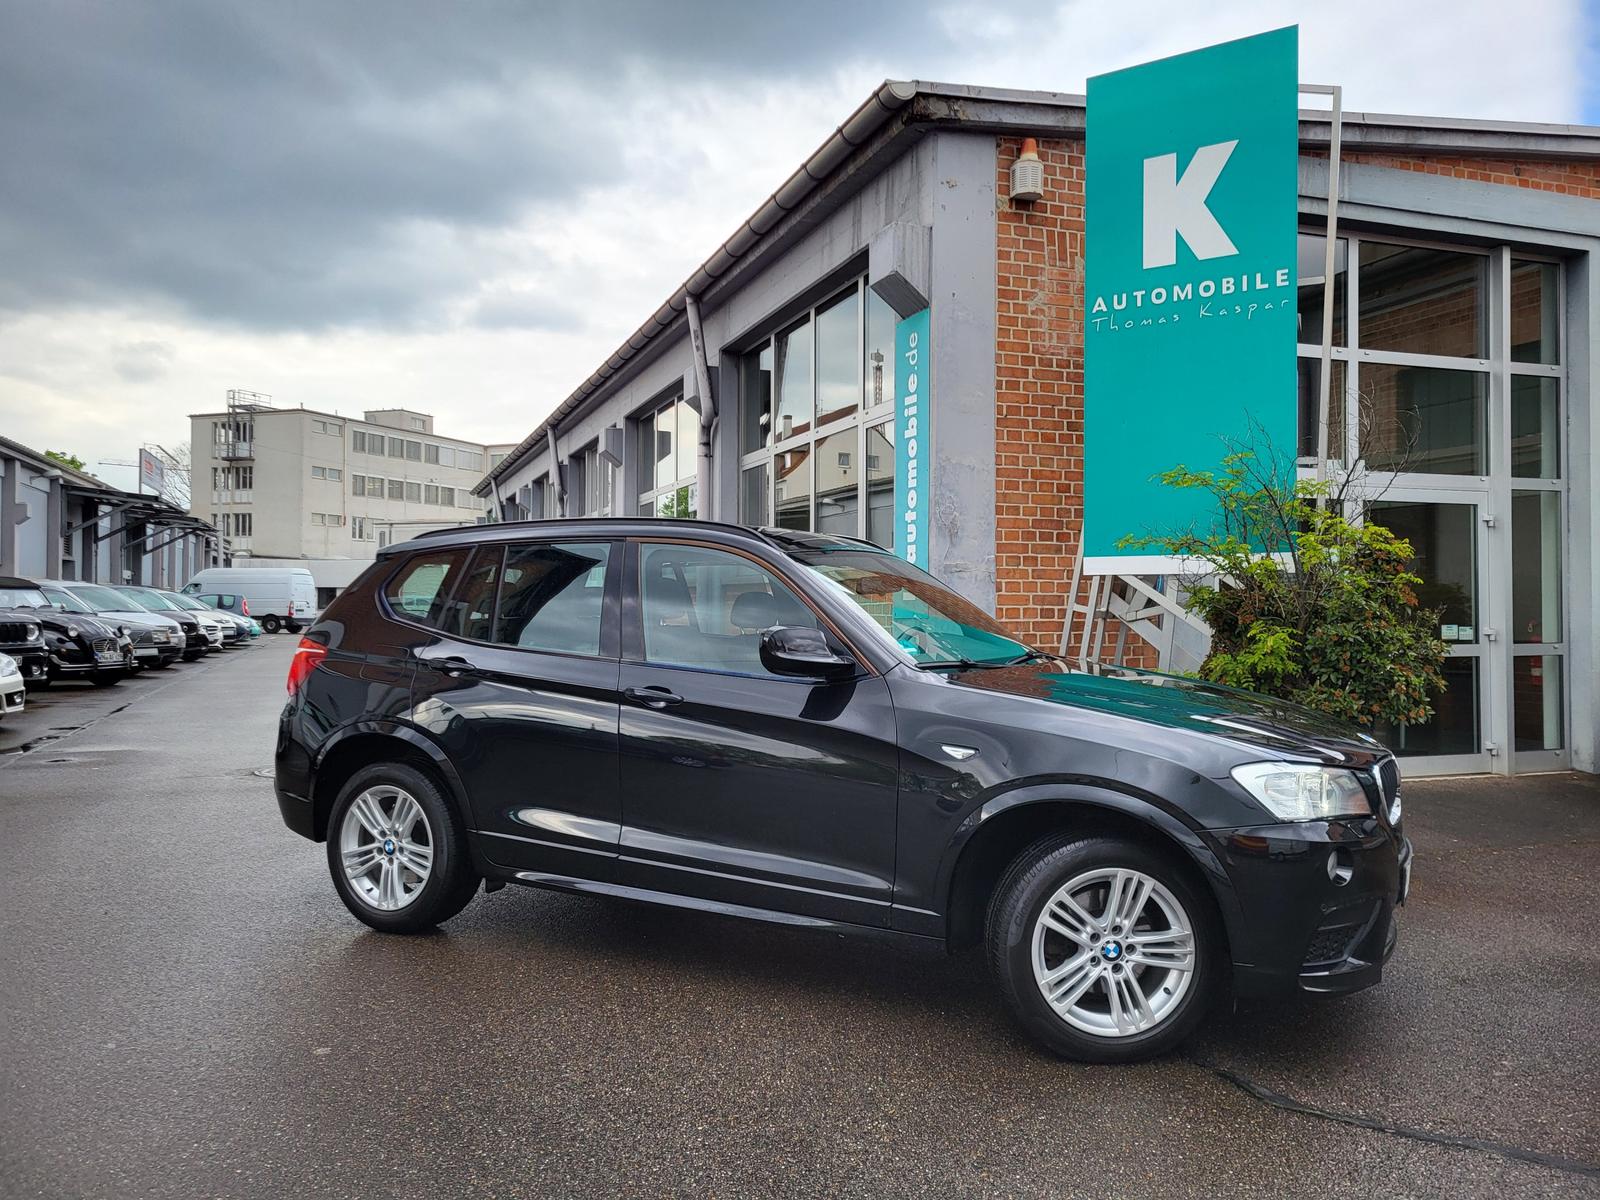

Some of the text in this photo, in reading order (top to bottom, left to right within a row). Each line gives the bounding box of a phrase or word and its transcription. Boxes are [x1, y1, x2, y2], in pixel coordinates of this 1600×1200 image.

[1142, 139, 1240, 270] K
[1092, 268, 1290, 314] AUTOMOBILE
[1091, 300, 1289, 332] Thomas Kaspar
